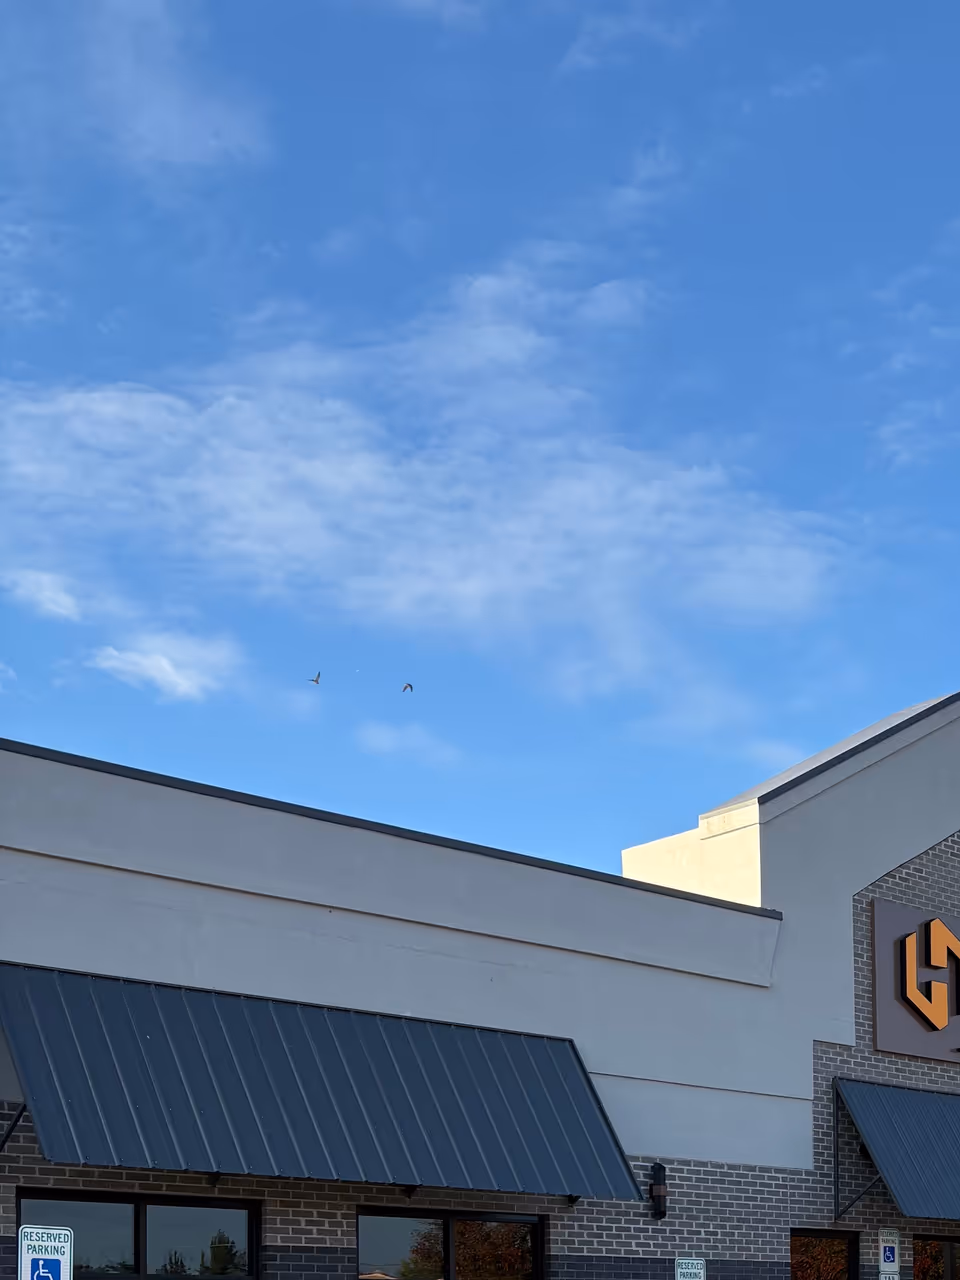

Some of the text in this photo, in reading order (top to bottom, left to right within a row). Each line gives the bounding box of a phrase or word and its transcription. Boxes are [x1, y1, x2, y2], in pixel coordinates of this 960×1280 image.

[23, 1231, 69, 1243] RESERVED
[26, 1244, 66, 1256] PARKING
[677, 1261, 703, 1270] RESERVED
[680, 1271, 702, 1280] PARKING
